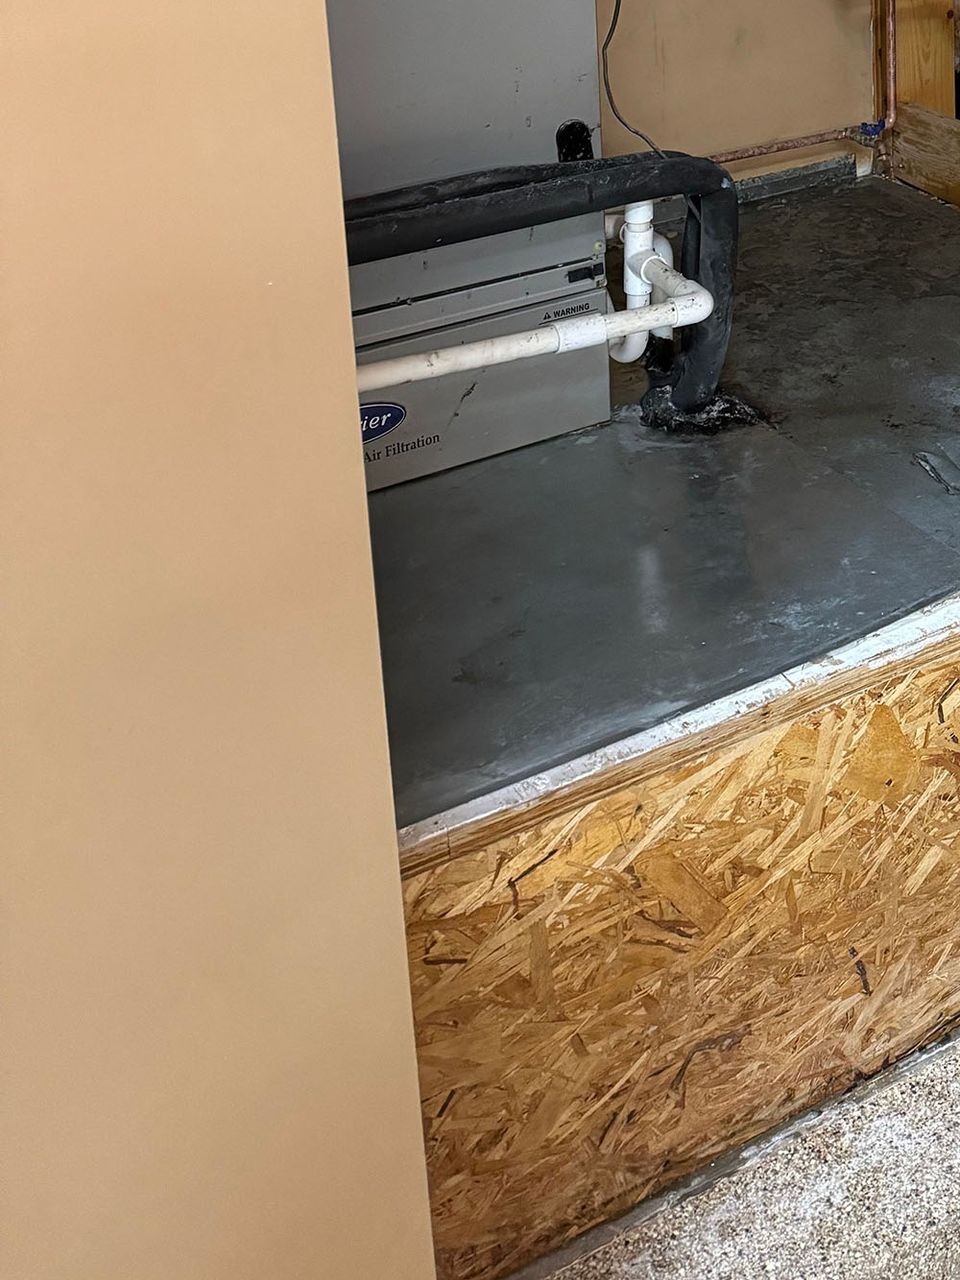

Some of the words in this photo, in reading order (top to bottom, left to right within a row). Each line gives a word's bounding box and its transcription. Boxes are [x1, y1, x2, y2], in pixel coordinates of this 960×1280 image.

[553, 302, 591, 319] WARNING
[364, 449, 382, 463] Air
[385, 434, 440, 458] Filtration
